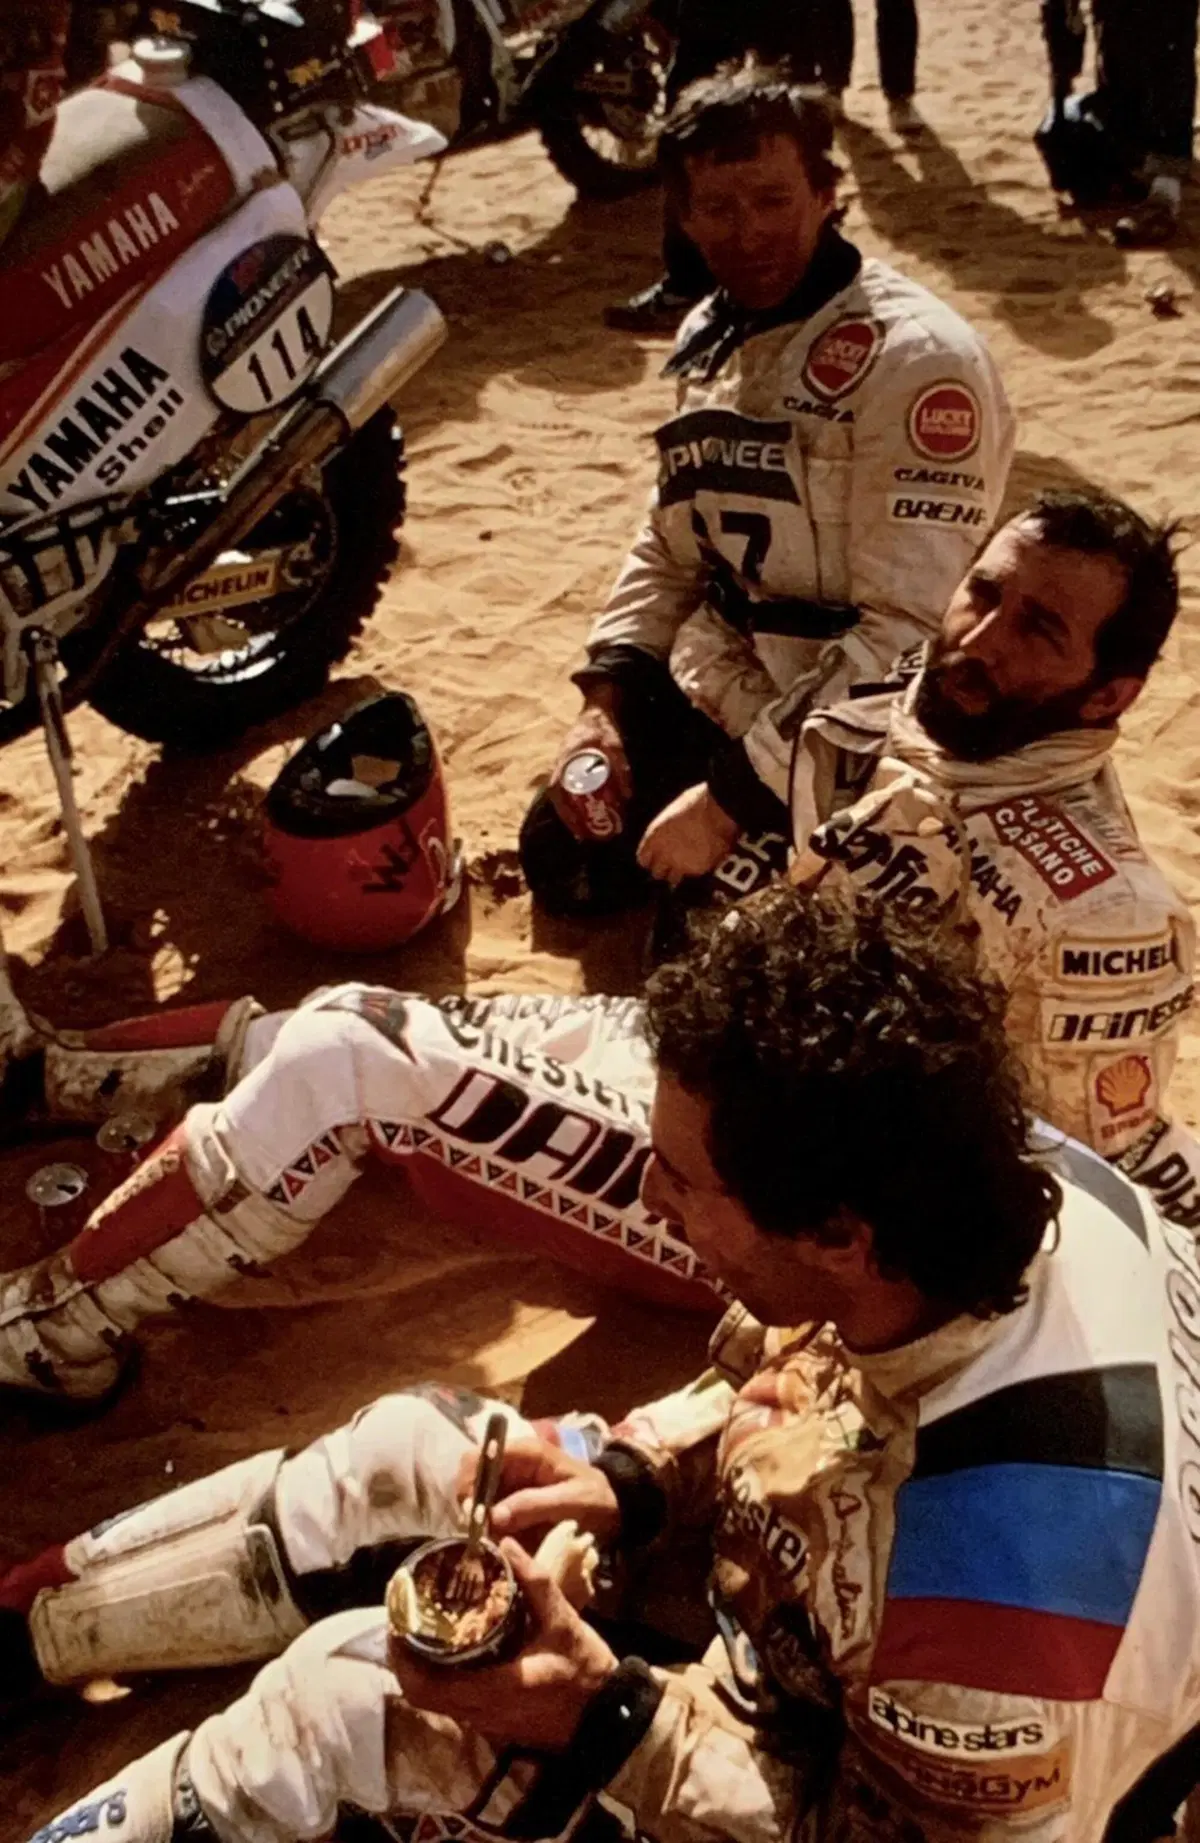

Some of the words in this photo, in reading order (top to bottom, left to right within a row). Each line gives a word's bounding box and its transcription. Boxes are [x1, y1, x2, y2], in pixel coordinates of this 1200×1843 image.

[40, 191, 181, 310] YAMAHA
[6, 346, 170, 512] YAMAHA
[96, 388, 184, 487] Shell
[894, 467, 985, 491] CAGIVA
[995, 808, 1075, 886] CASANO
[872, 1695, 1044, 1751] alpinestars
